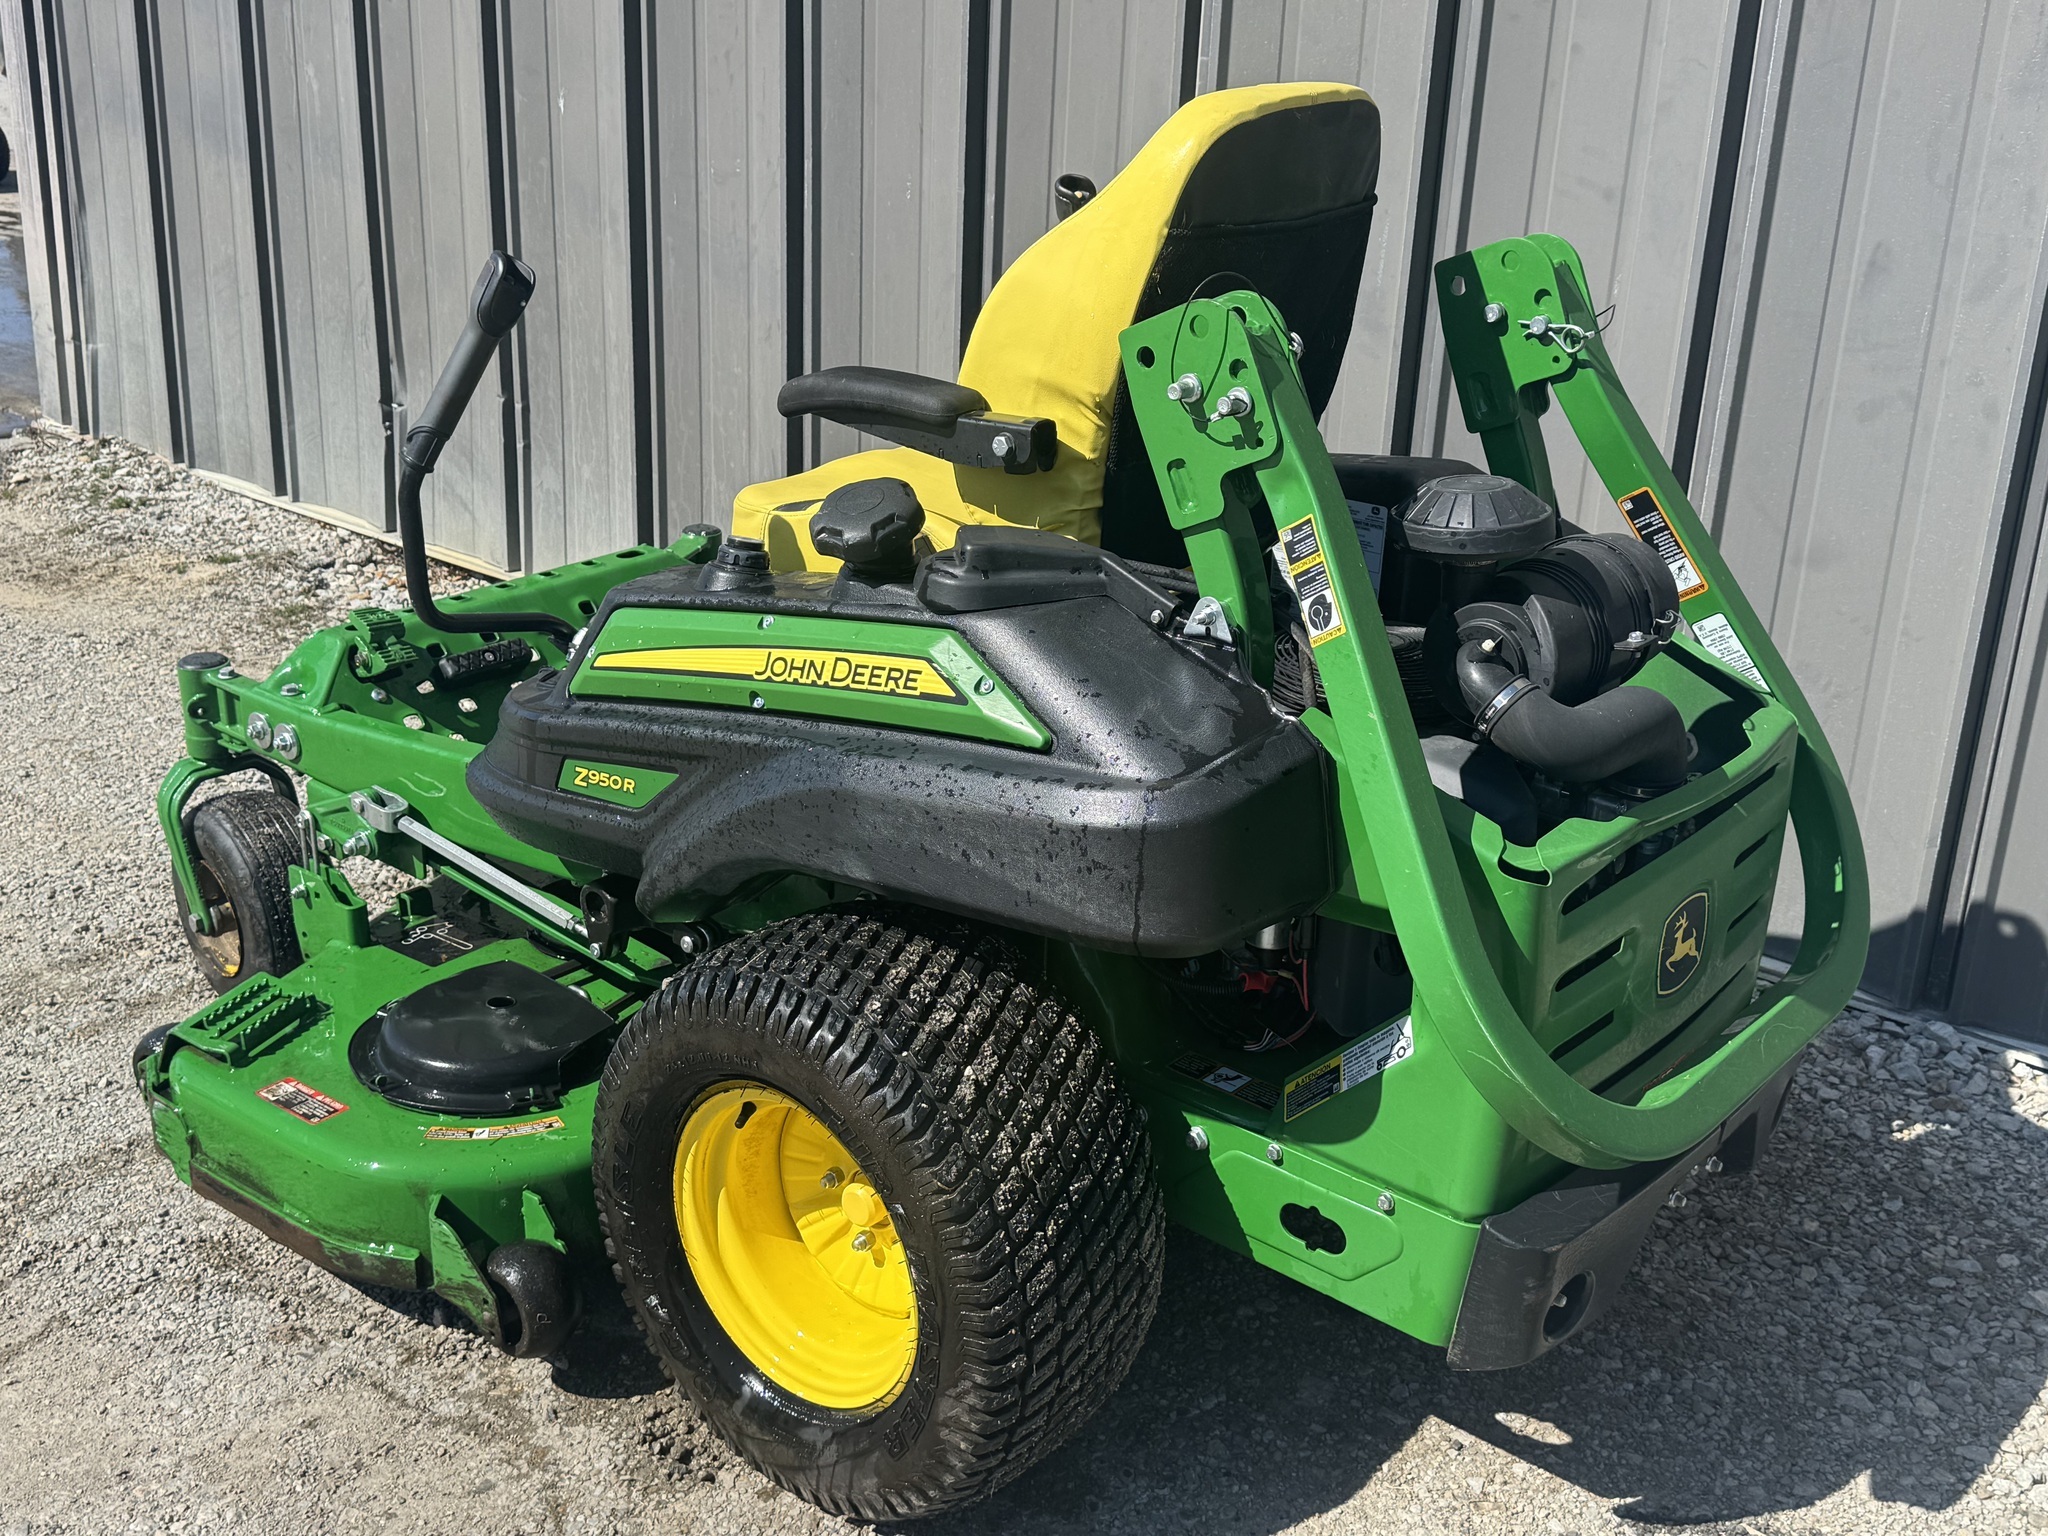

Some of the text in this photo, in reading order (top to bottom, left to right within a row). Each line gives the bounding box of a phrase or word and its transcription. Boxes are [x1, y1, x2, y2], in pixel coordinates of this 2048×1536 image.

[1312, 630, 1338, 646] CAUTION
[754, 650, 923, 692] JOHN DEERE
[573, 766, 636, 794] Z950R
